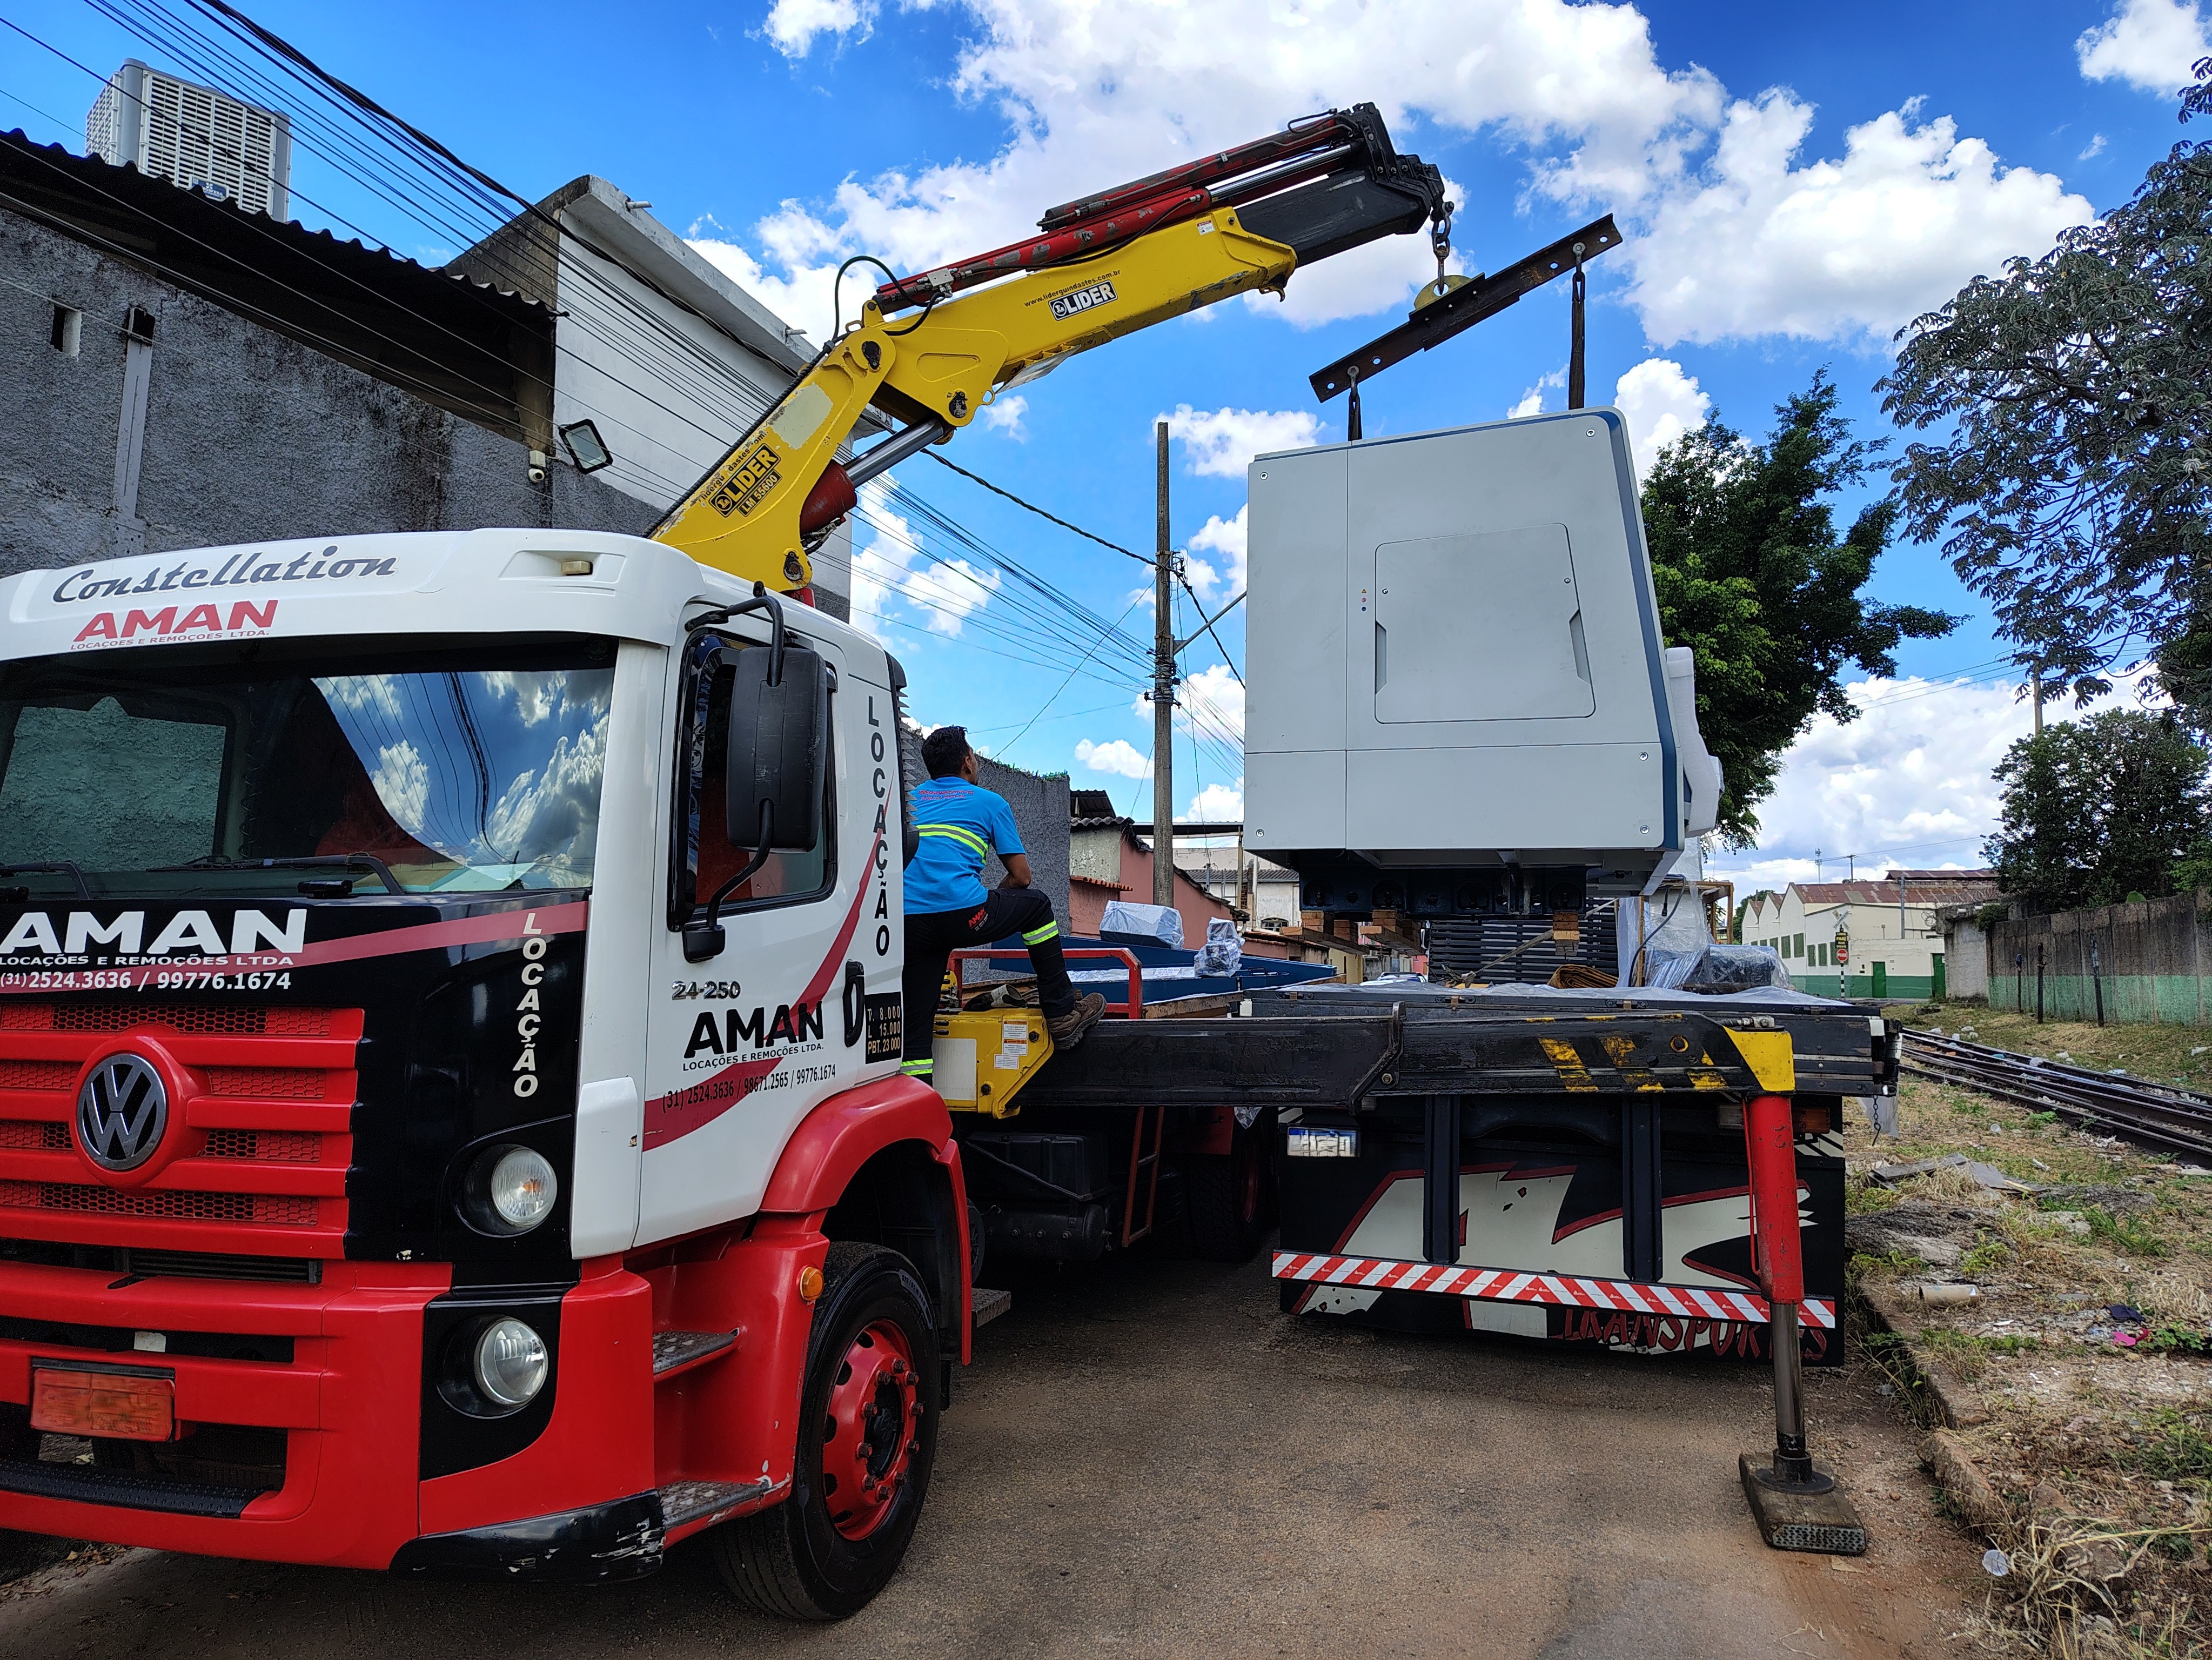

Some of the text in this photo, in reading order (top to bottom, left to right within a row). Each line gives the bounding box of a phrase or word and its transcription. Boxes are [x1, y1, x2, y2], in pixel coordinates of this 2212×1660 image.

[1024, 269, 1121, 307] www.liderguindastes.com.br
[1063, 284, 1115, 313] LIDER
[723, 449, 777, 503] LIDER
[742, 474, 777, 512] LM 55600
[54, 545, 397, 603] Constellation
[73, 600, 278, 642] AMAN
[868, 695, 889, 956] LOCAÇÃO
[0, 909, 307, 953] AMAN
[0, 954, 293, 967] LOCAÇÕES E REMOÇÕES LTDA
[157, 972, 291, 989] 99776.1674
[671, 981, 741, 1000] 24-250
[513, 913, 547, 1097] LOCAÇÃO
[880, 1006, 901, 1020] 8.000
[683, 1001, 823, 1058] AMAN
[868, 1040, 881, 1055] PBT.
[880, 1021, 901, 1036] 15.000
[683, 1054, 738, 1072] LOCAÇÕES
[750, 1046, 799, 1060] REMOÇÕES
[801, 1043, 824, 1053] LTDA.
[662, 1088, 684, 1113] (31)
[687, 1080, 734, 1105] 2524.3636
[744, 1072, 788, 1095] 98671.2565
[796, 1063, 835, 1085] 99776.1674
